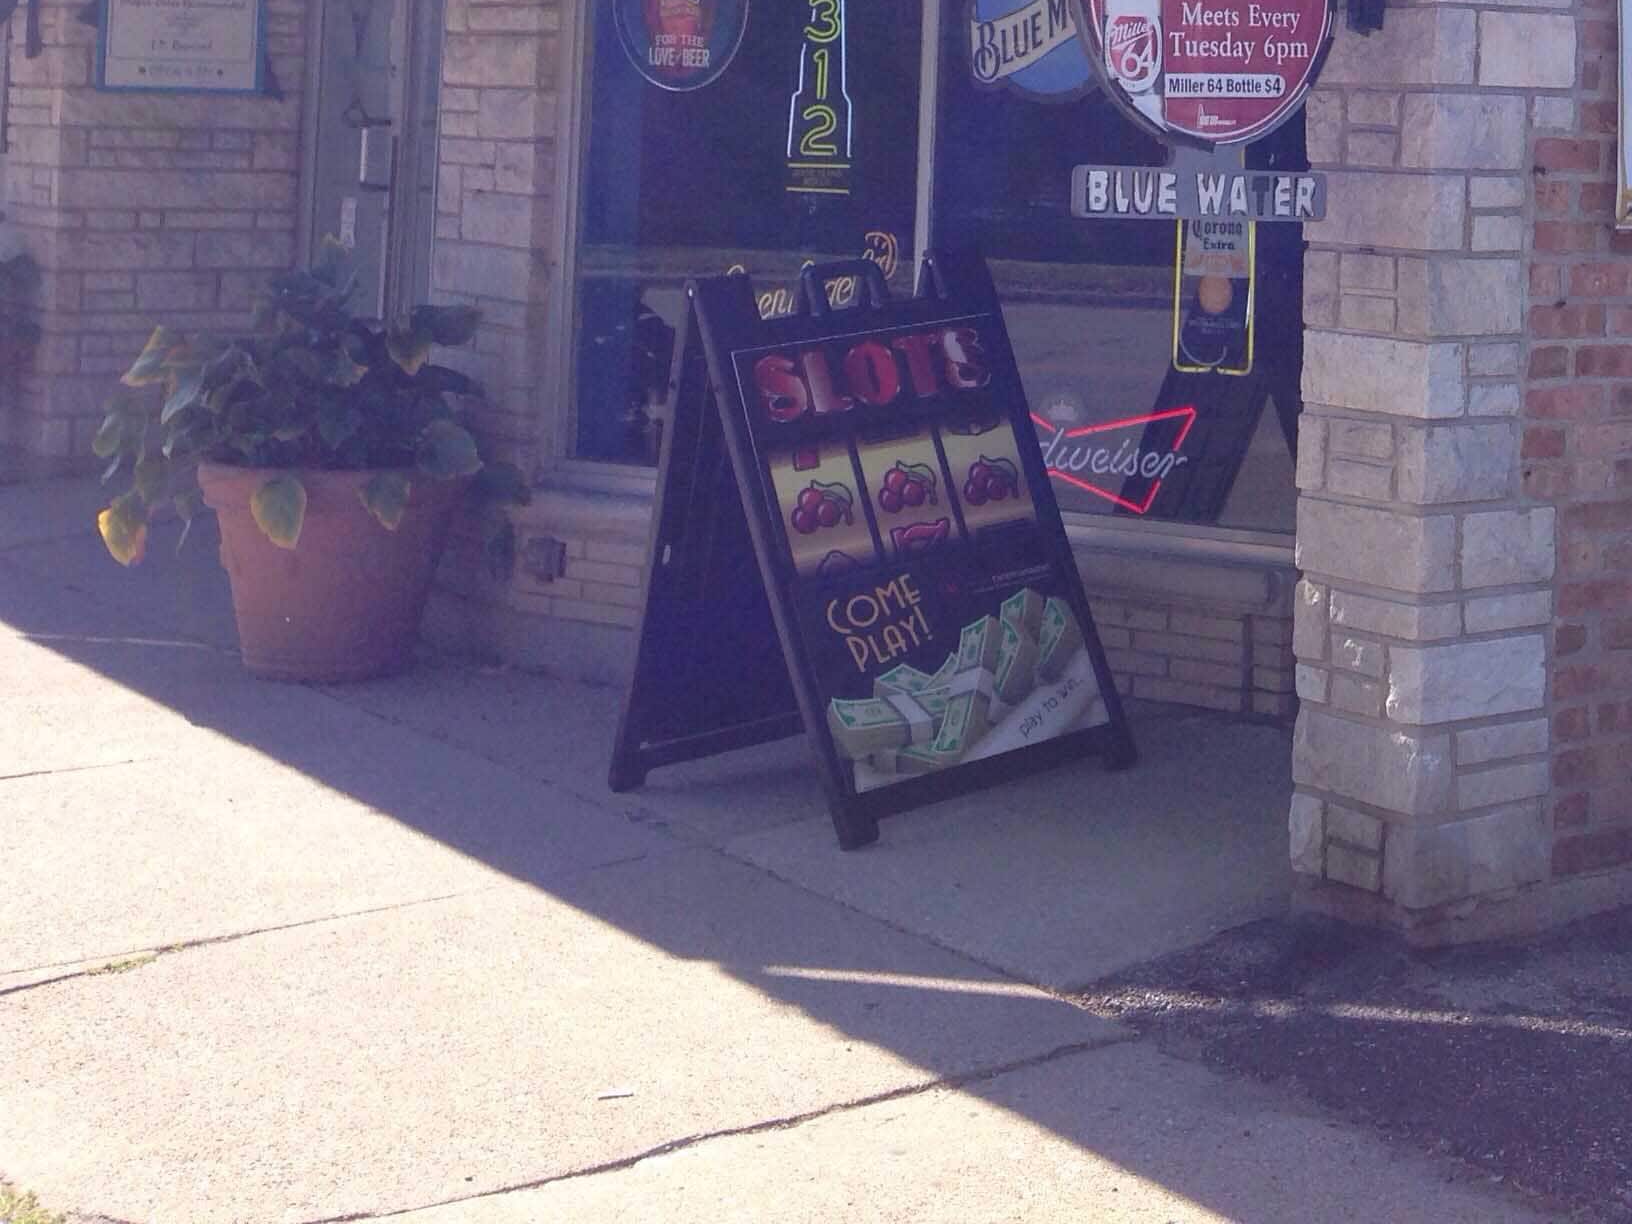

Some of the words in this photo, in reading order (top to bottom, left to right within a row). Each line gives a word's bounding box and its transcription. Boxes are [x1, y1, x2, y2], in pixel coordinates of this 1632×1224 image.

[1181, 2, 1239, 27] Meets
[1248, 4, 1301, 34] Every
[648, 47, 675, 67] LOVE
[683, 48, 710, 68] BEER
[974, 12, 1043, 80] BLUE
[1121, 38, 1154, 77] 64
[1169, 32, 1255, 66] Tuesday
[1264, 35, 1308, 67] 6pm
[1169, 78, 1204, 93] Miller
[1207, 78, 1223, 93] 64
[1227, 78, 1261, 93] Bottle
[1265, 77, 1282, 94] $4
[1087, 170, 1177, 213] BLUE
[1197, 173, 1316, 216] WATER
[755, 328, 991, 423] SLOTS
[1039, 426, 1188, 479] dweiser
[827, 574, 921, 635] COME
[846, 605, 933, 673] PLAY!
[1019, 712, 1043, 738] play
